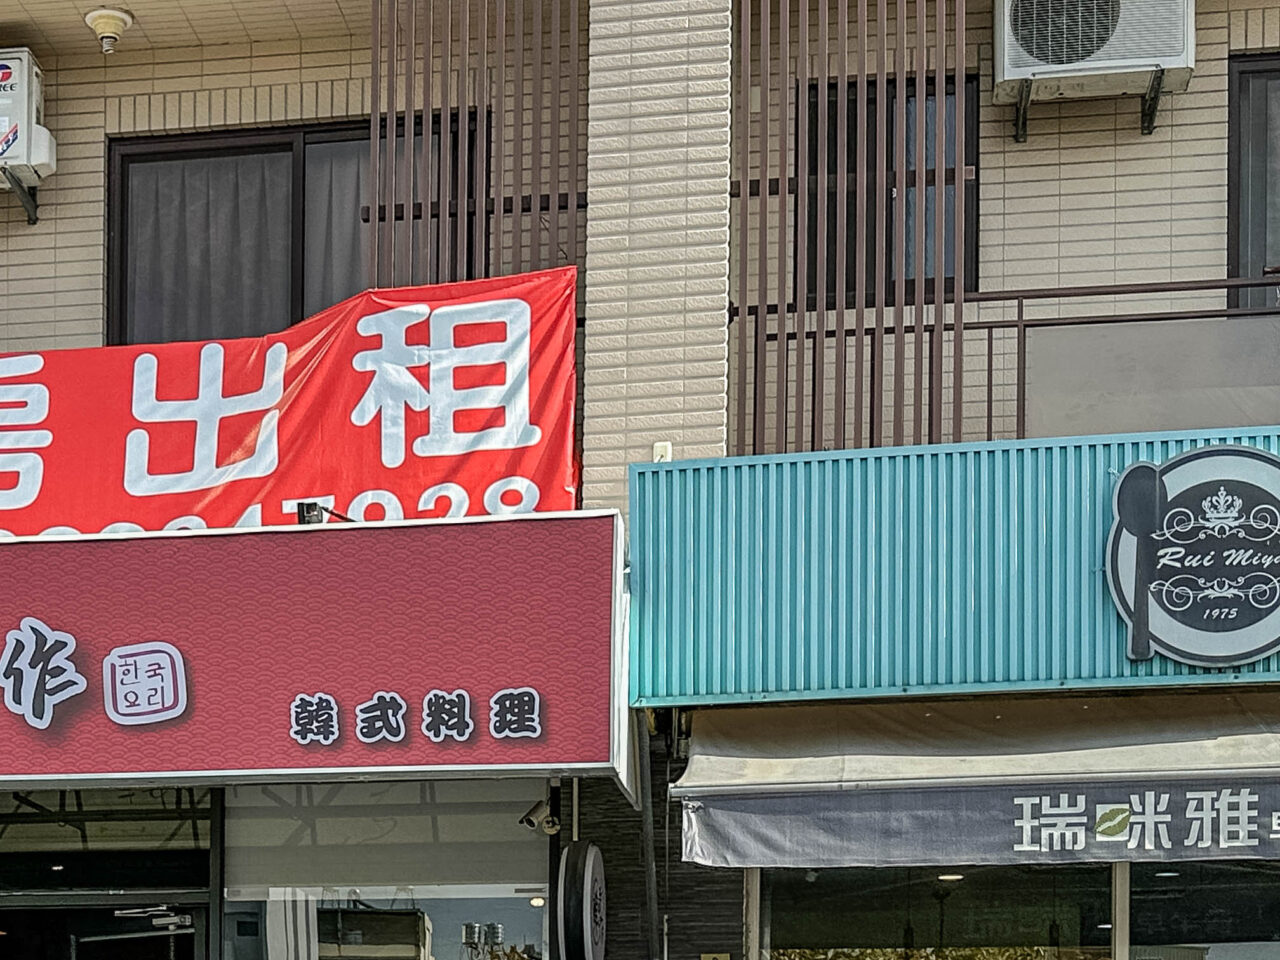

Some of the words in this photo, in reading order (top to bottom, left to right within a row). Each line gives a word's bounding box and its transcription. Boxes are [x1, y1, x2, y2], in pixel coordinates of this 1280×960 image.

[1156, 547, 1215, 569] Rui
[1203, 608, 1238, 619] 1975
[118, 657, 166, 686] 한국
[123, 686, 167, 709] 요리
[290, 687, 543, 745] 韓式料理
